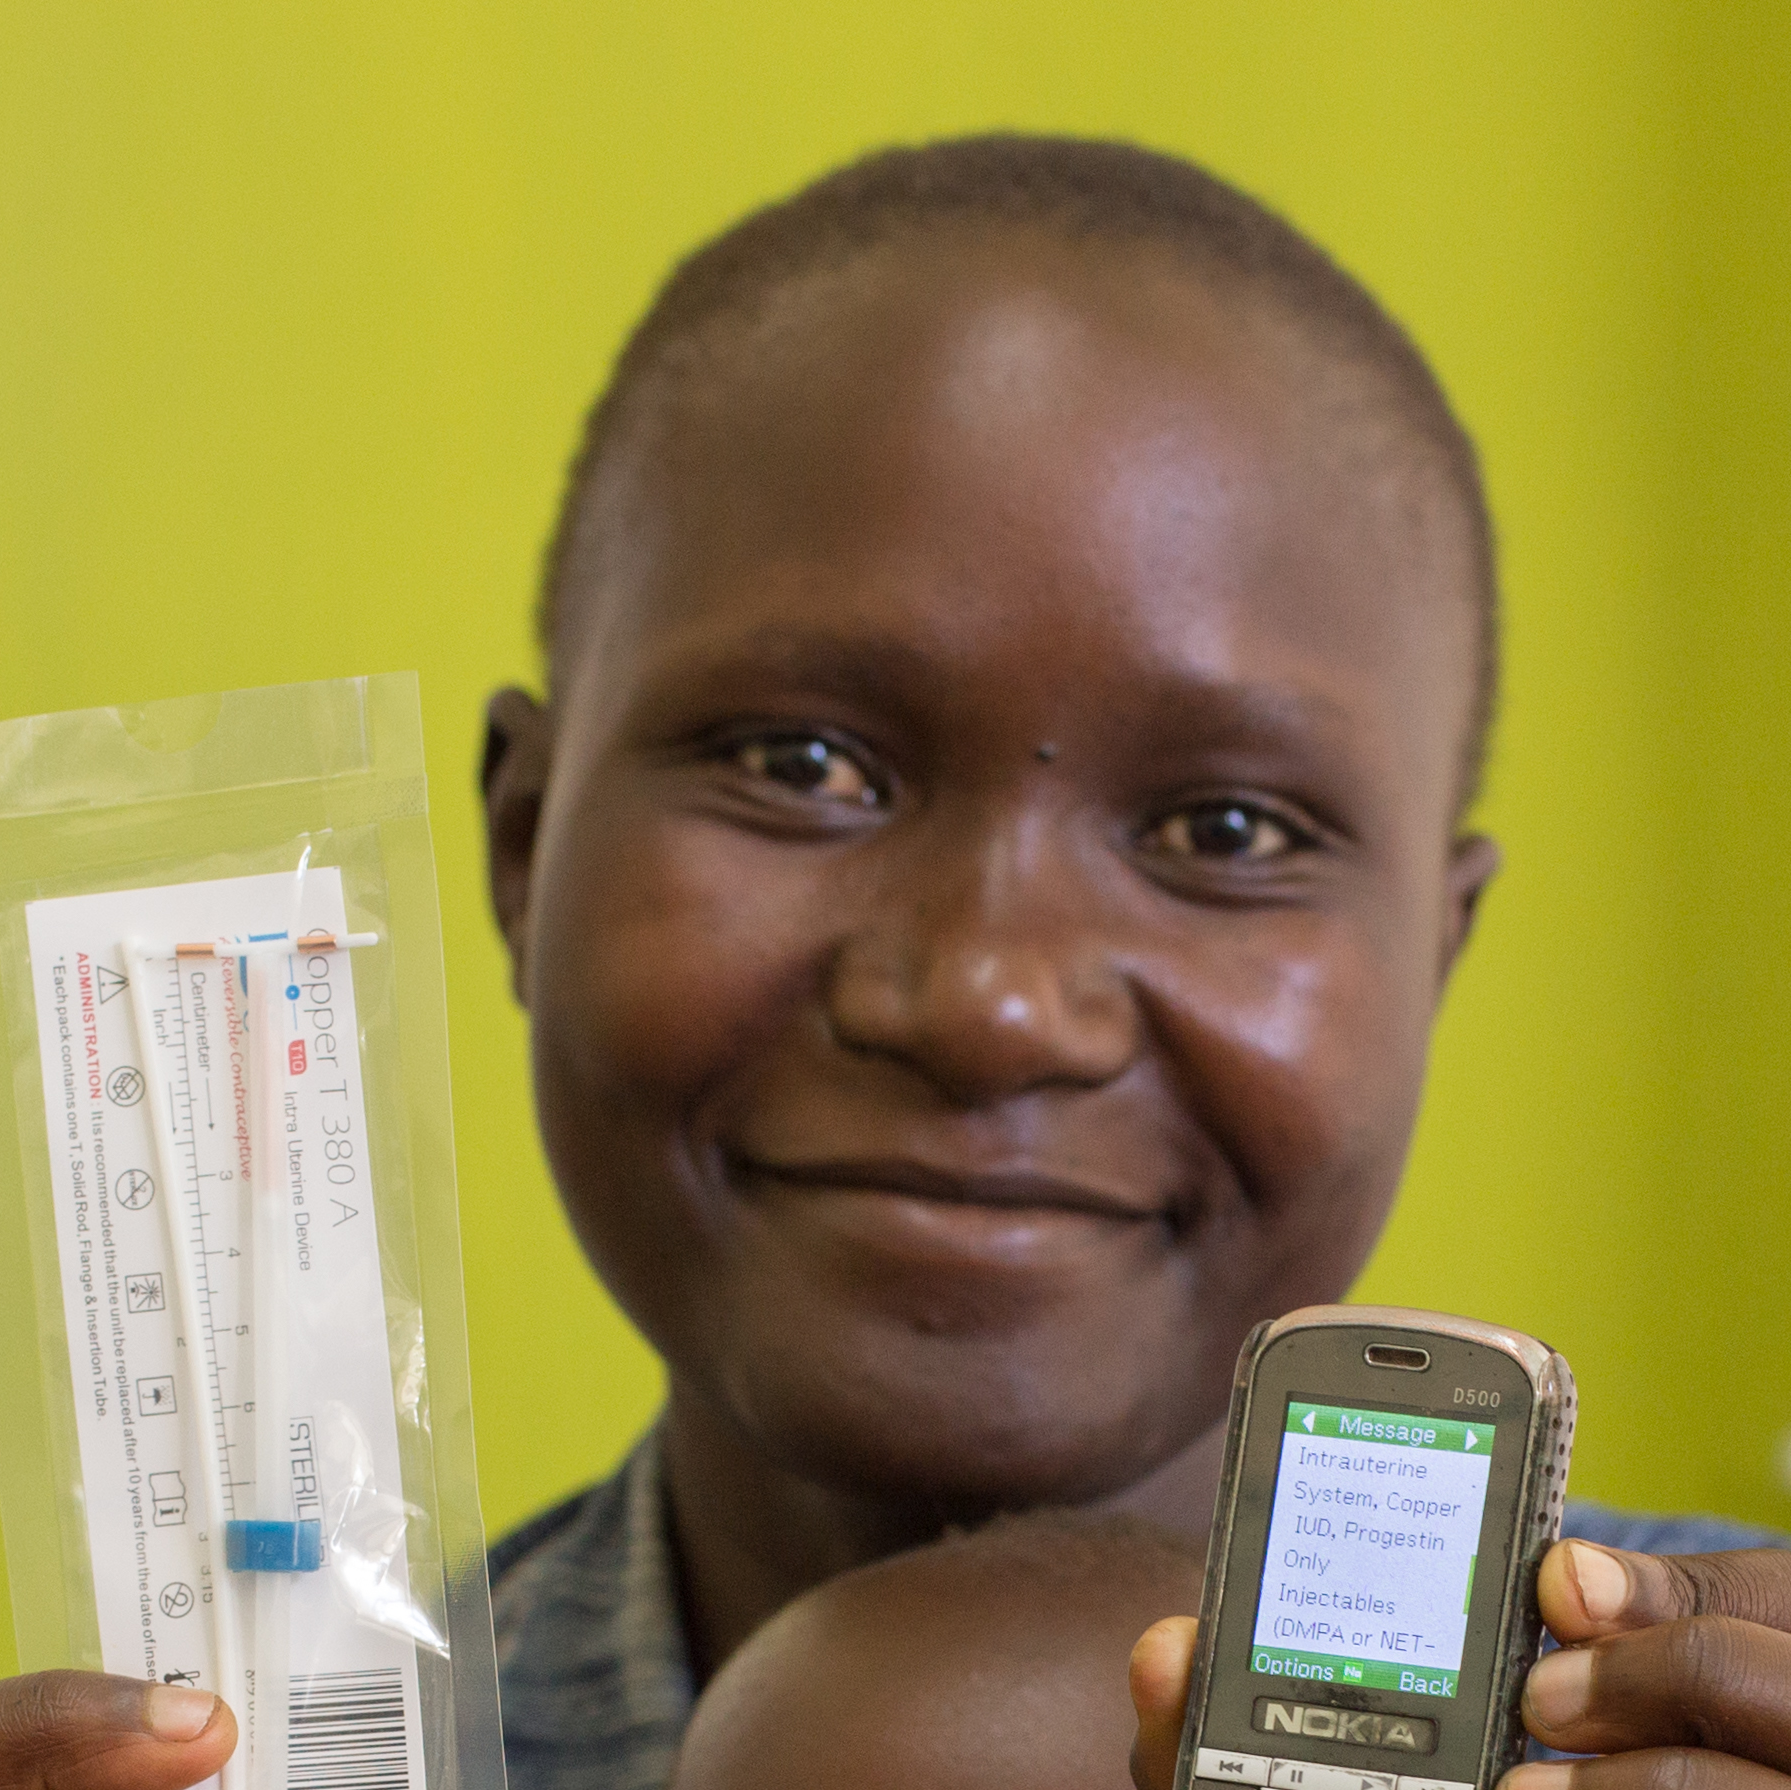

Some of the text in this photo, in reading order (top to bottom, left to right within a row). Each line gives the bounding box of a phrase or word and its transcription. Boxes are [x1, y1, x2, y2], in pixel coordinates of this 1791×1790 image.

[219, 955, 244, 1050] Reversible
[75, 951, 103, 1100] ADMINISTRATION
[188, 970, 215, 1073] Centimeter
[290, 1044, 304, 1071] T10
[318, 1079, 348, 1105] T
[90, 1109, 104, 1121] It
[91, 1122, 106, 1135] is
[224, 1050, 256, 1182] Contraceptive
[321, 1113, 356, 1187] 380
[51, 964, 109, 1421] Each pack contains one T, Solid Rod, Flange & Insertion Tube.
[92, 1137, 117, 1247] recommended
[282, 1091, 314, 1273] Intra Uterine Device
[329, 1197, 360, 1229] A
[103, 1250, 120, 1279] that
[106, 1280, 123, 1305] the
[218, 1169, 257, 1413] 3 4 5 6
[109, 1306, 125, 1336] unit
[113, 1337, 127, 1356] be
[113, 1358, 135, 1426] replaced
[1452, 1386, 1501, 1409] D500
[122, 1428, 141, 1464] after
[1338, 1413, 1437, 1448] Message
[127, 1465, 143, 1485] 10
[1297, 1445, 1428, 1481] Intrauterine
[127, 1485, 146, 1530] years
[1292, 1479, 1462, 1520] System, Copper
[133, 1531, 151, 1566] from
[1295, 1513, 1446, 1552] IUD, Progestin
[136, 1567, 153, 1591] the
[1283, 1547, 1331, 1577] Only
[138, 1593, 155, 1628] date
[1277, 1581, 1397, 1617] Injectables
[141, 1629, 157, 1645] of
[1272, 1614, 1437, 1655] (DMPA or NET-
[1253, 1652, 1336, 1683] Options
[1398, 1670, 1455, 1698] Back
[1263, 1702, 1417, 1750] NOKIA
